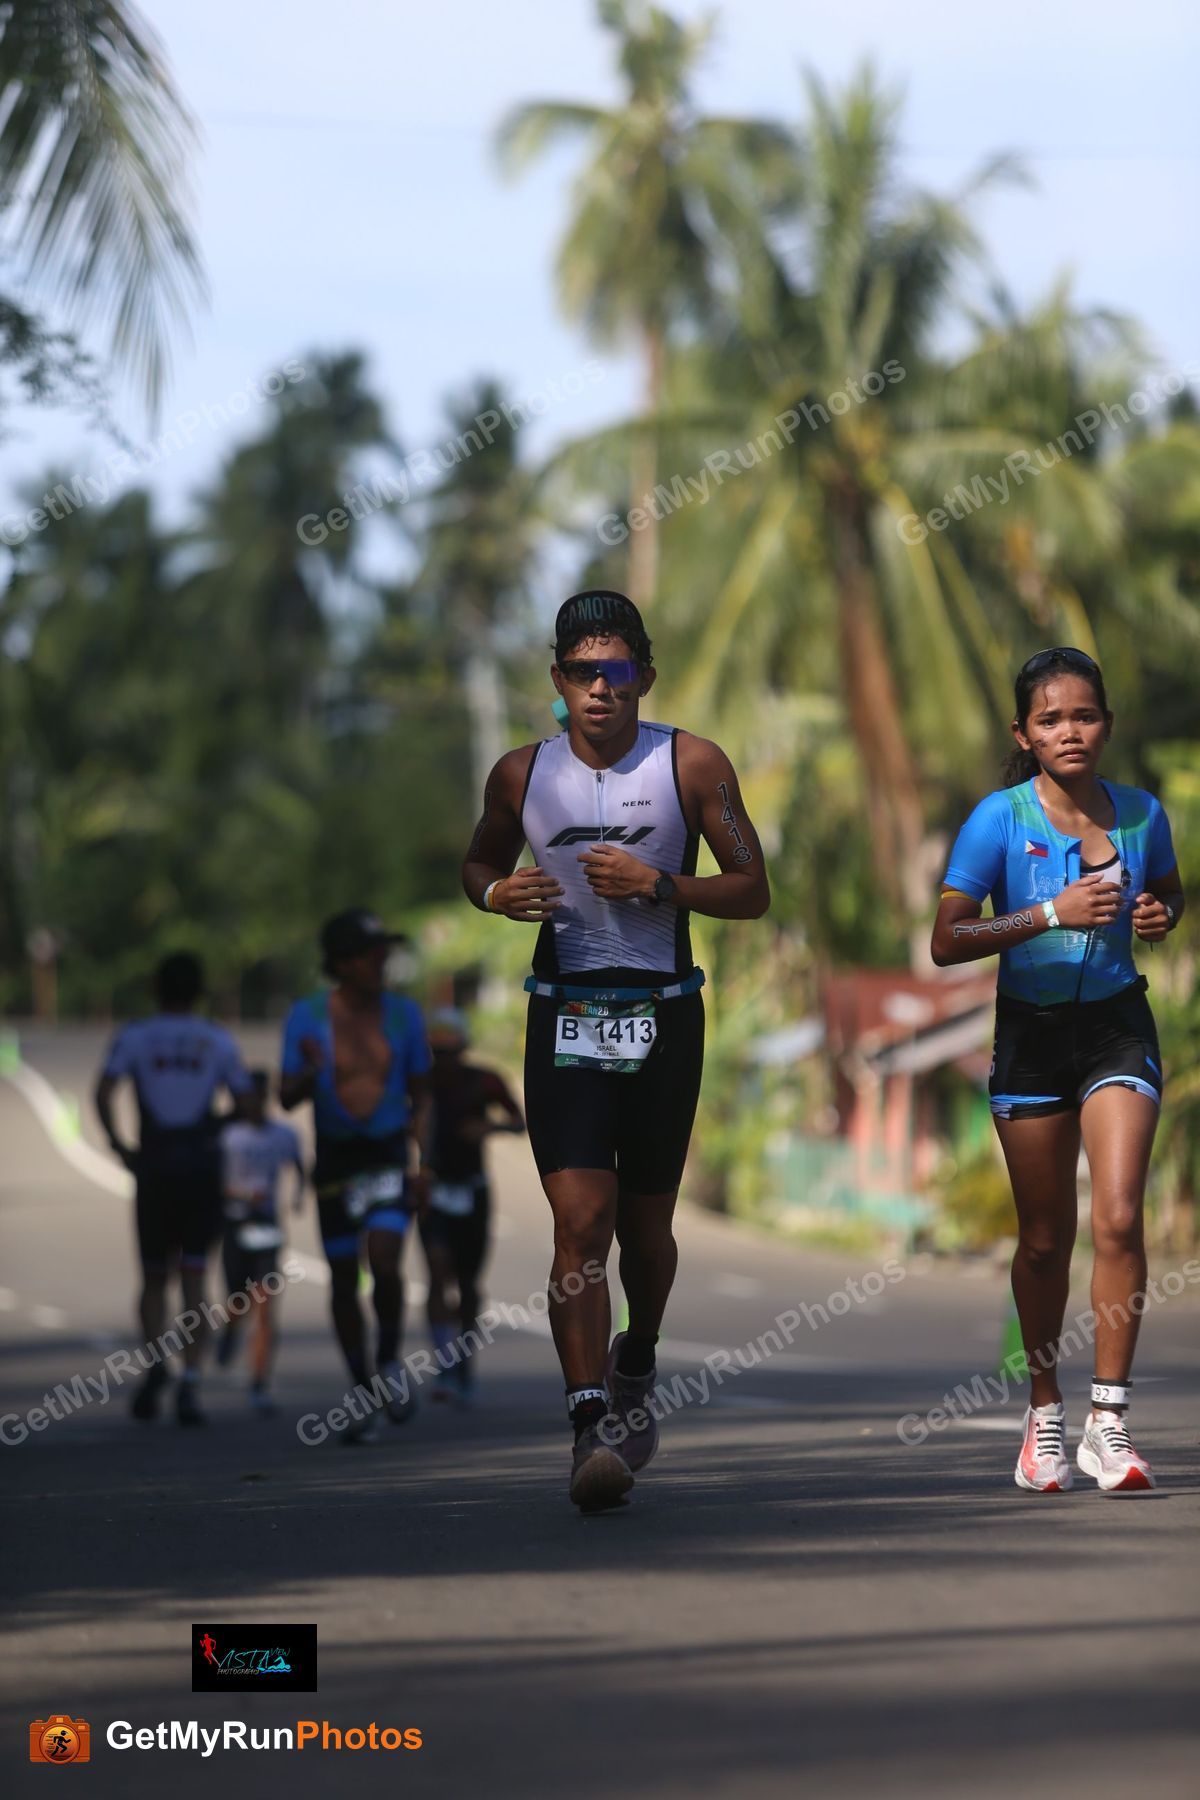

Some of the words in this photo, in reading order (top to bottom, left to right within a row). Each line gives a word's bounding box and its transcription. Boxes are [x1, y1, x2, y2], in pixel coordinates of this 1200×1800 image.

[718, 782, 752, 864] 1413
[953, 911, 1034, 937] 1192
[561, 1018, 579, 1041] B
[594, 1019, 654, 1044] 1413
